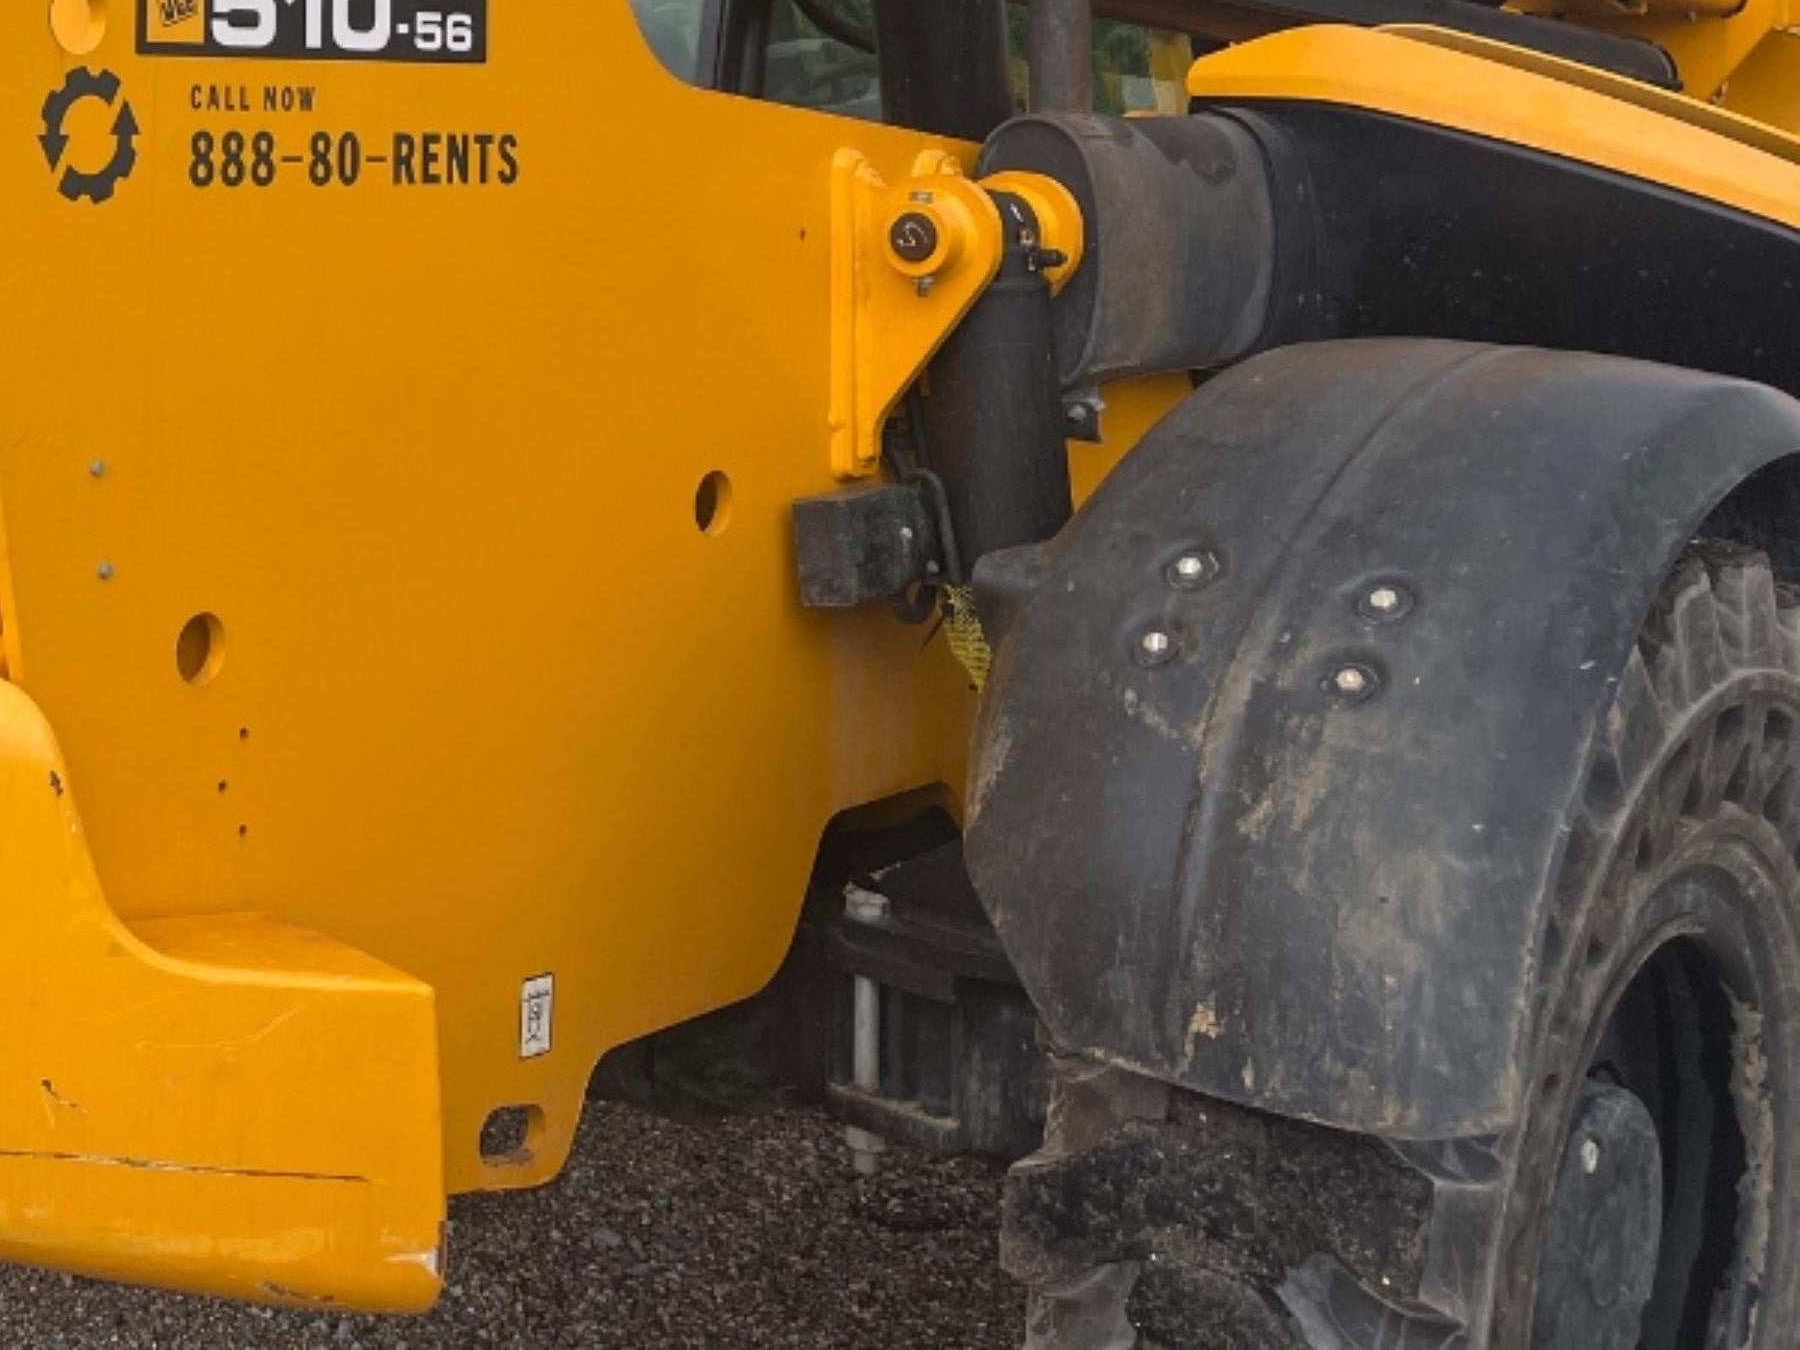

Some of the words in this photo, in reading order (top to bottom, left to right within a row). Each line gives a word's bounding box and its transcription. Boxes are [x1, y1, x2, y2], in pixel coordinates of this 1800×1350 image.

[190, 84, 250, 111] CALL
[263, 86, 316, 112] NOW
[188, 130, 519, 188] 888-80-RENTS
